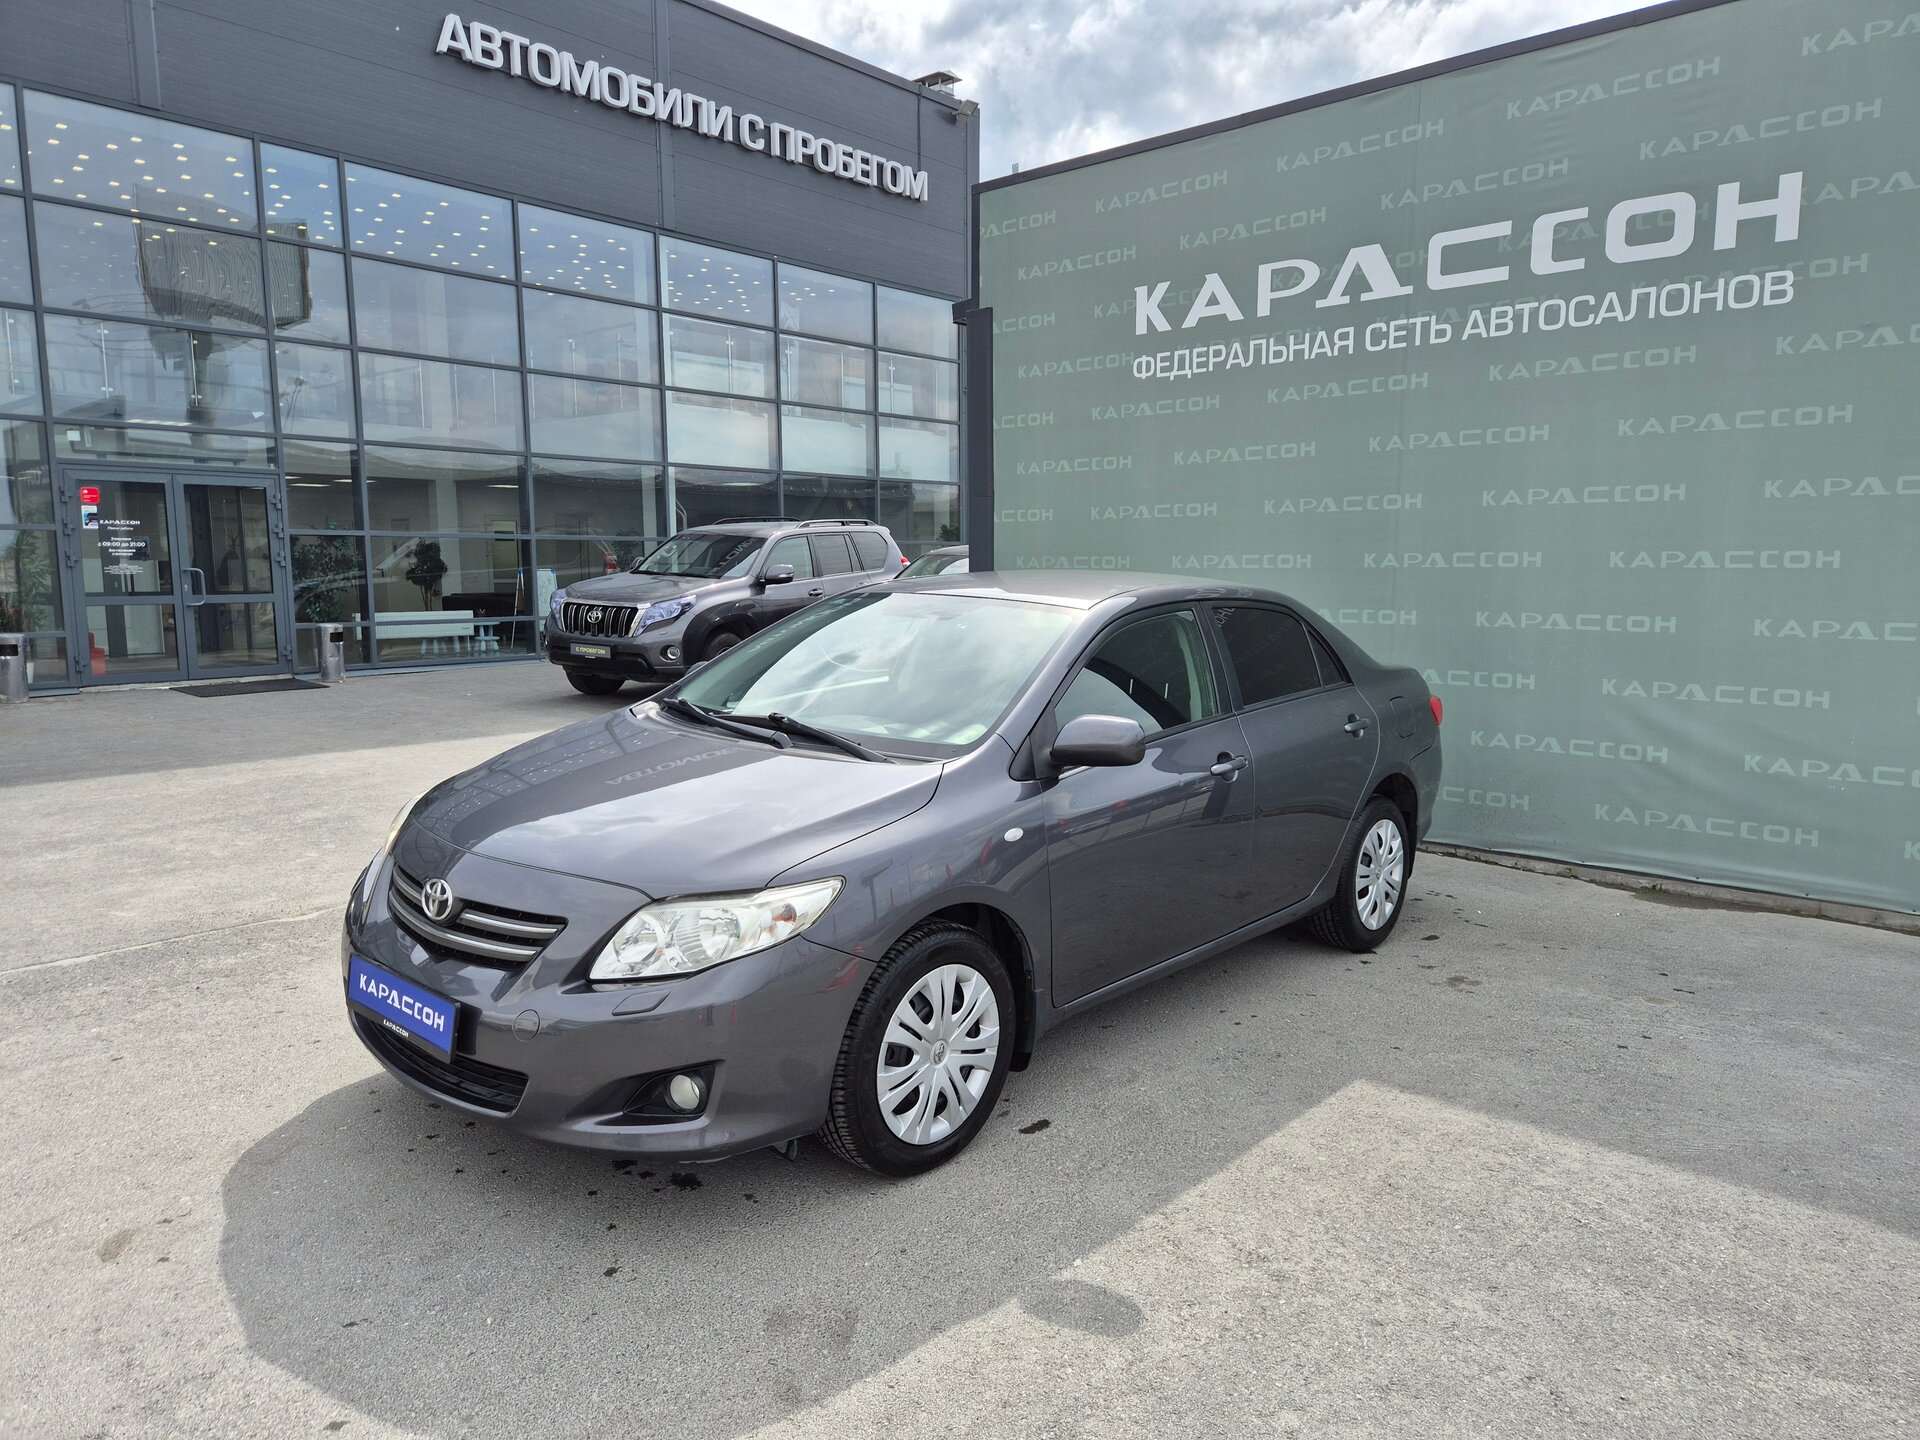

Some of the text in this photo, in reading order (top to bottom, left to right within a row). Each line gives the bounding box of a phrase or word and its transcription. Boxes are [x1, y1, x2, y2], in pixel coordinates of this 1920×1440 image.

[1506, 56, 1721, 120] КАРАССОН
[435, 12, 928, 201] АВТОМОБИЛИ С ПРОБЕГОМ
[1640, 98, 1882, 160] КАРАССОН
[1276, 118, 1445, 173] КАРАССОН
[1095, 170, 1229, 215] КАРАССОН
[1380, 157, 1569, 211] КАРАССОН
[1180, 206, 1327, 250] КАРАССОН
[1017, 245, 1137, 281] КАРАССОН
[1135, 171, 1803, 335] КАРАССОН
[1133, 269, 1795, 380] ФЕДЕРАЛЬНАЯ СЕТЬ АВТОСАЛОНОВ
[1018, 352, 1135, 379] КАРАССОН
[1488, 345, 1697, 382] КАРАССОН
[1267, 372, 1429, 404] КАРАССОН
[1092, 395, 1220, 422] КАРАССОН
[1617, 404, 1853, 437] КАРАССОН
[1174, 441, 1316, 465] КАРАССОН
[1369, 424, 1550, 453] КАРАССОН
[1016, 455, 1133, 475] КАРАССОН
[1090, 502, 1218, 520] КАРАССОН
[1263, 493, 1423, 514] КАРАССОН
[1481, 483, 1686, 507] КАРАССОН
[1016, 555, 1130, 570] КАРАССОН
[1171, 553, 1313, 569] КАРАССОН
[1363, 551, 1542, 568] КАРАССОН
[1609, 550, 1841, 569] КАРАССОН
[1475, 611, 1677, 634] КАРАССОН
[1601, 678, 1831, 710] КАРАССОН
[1470, 730, 1669, 764] КАРАССОН
[1594, 804, 1819, 848] КАРАССОН
[359, 973, 445, 1032] КАРАССОН
[383, 1019, 409, 1038] КАРАССОН
